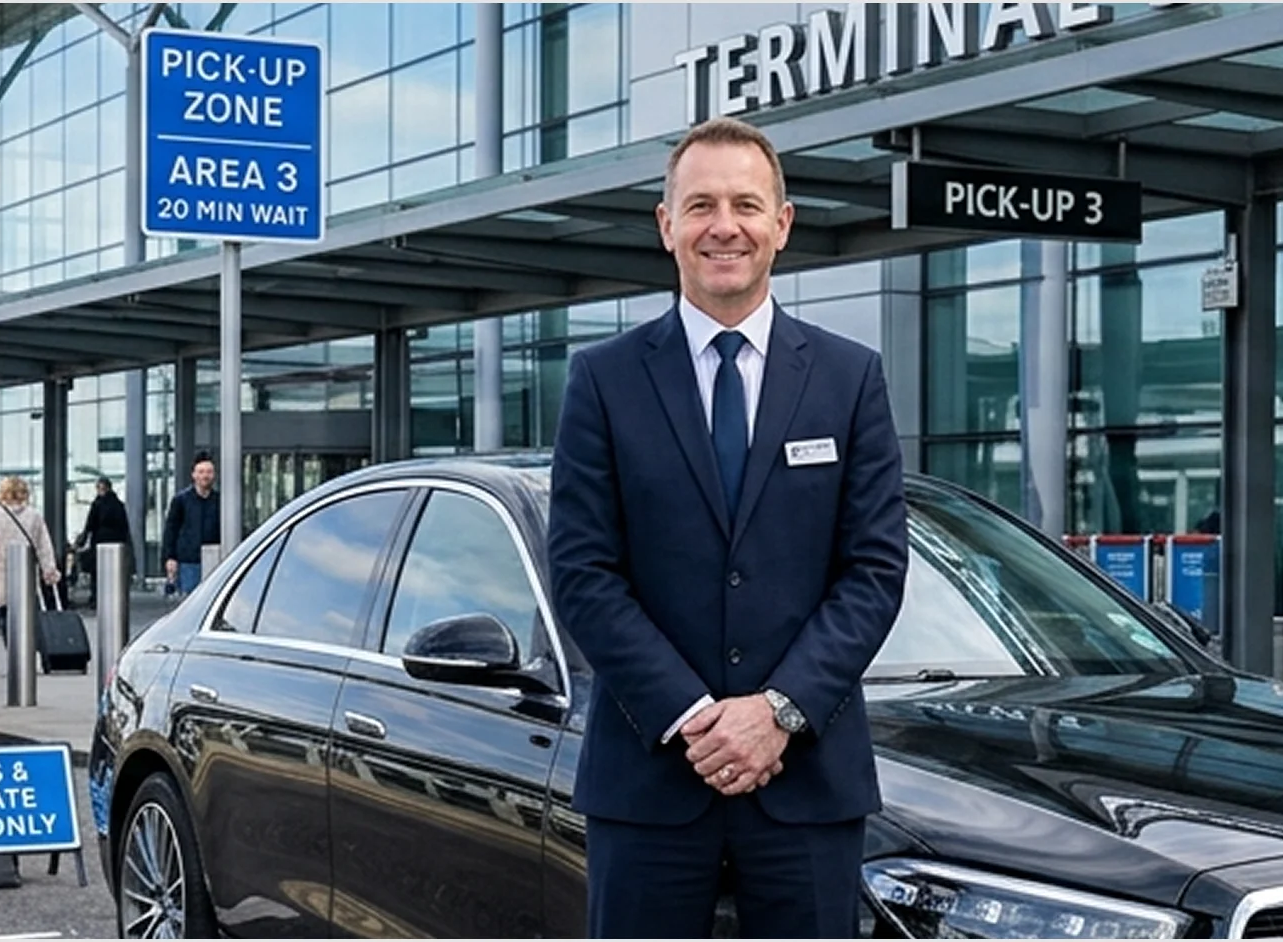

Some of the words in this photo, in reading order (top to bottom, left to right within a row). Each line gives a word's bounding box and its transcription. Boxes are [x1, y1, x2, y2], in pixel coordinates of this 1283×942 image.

[162, 48, 306, 86] PICK-UP
[183, 90, 284, 128] ZONE
[169, 155, 265, 191] AREA
[277, 162, 298, 192] 3
[157, 197, 189, 219] 20
[196, 200, 243, 222] MIN
[250, 203, 308, 226] WAIT
[945, 181, 1075, 222] PICK-UP
[1084, 191, 1103, 225] 3
[12, 761, 28, 781] &
